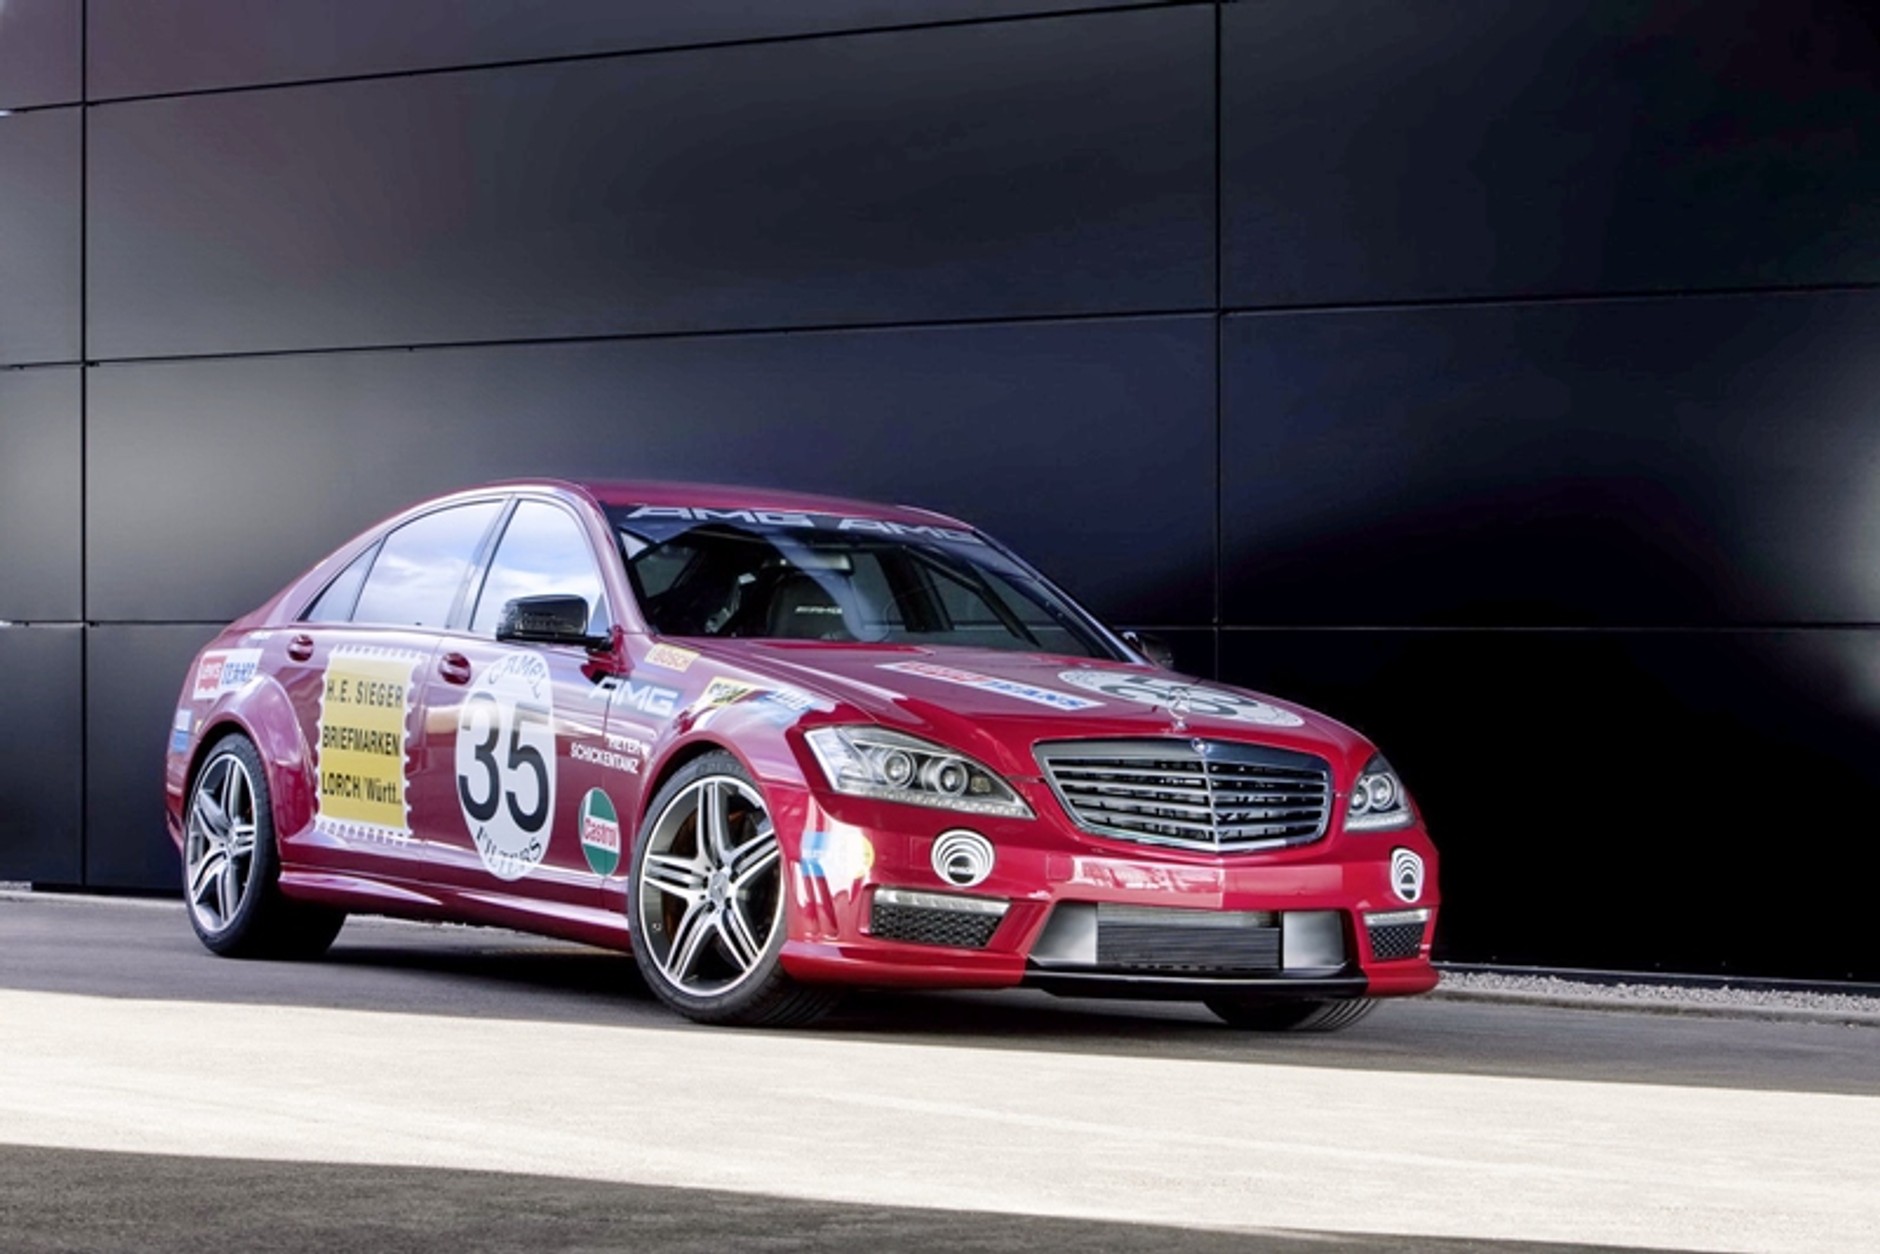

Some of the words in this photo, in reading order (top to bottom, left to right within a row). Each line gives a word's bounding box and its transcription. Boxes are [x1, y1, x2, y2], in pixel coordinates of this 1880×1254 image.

[626, 506, 815, 528] AMG
[838, 518, 986, 546] AMG
[355, 680, 404, 708] SIEGER
[589, 676, 679, 716] AMG
[322, 724, 401, 758] BRIEFMARKEN
[458, 691, 550, 834] 35
